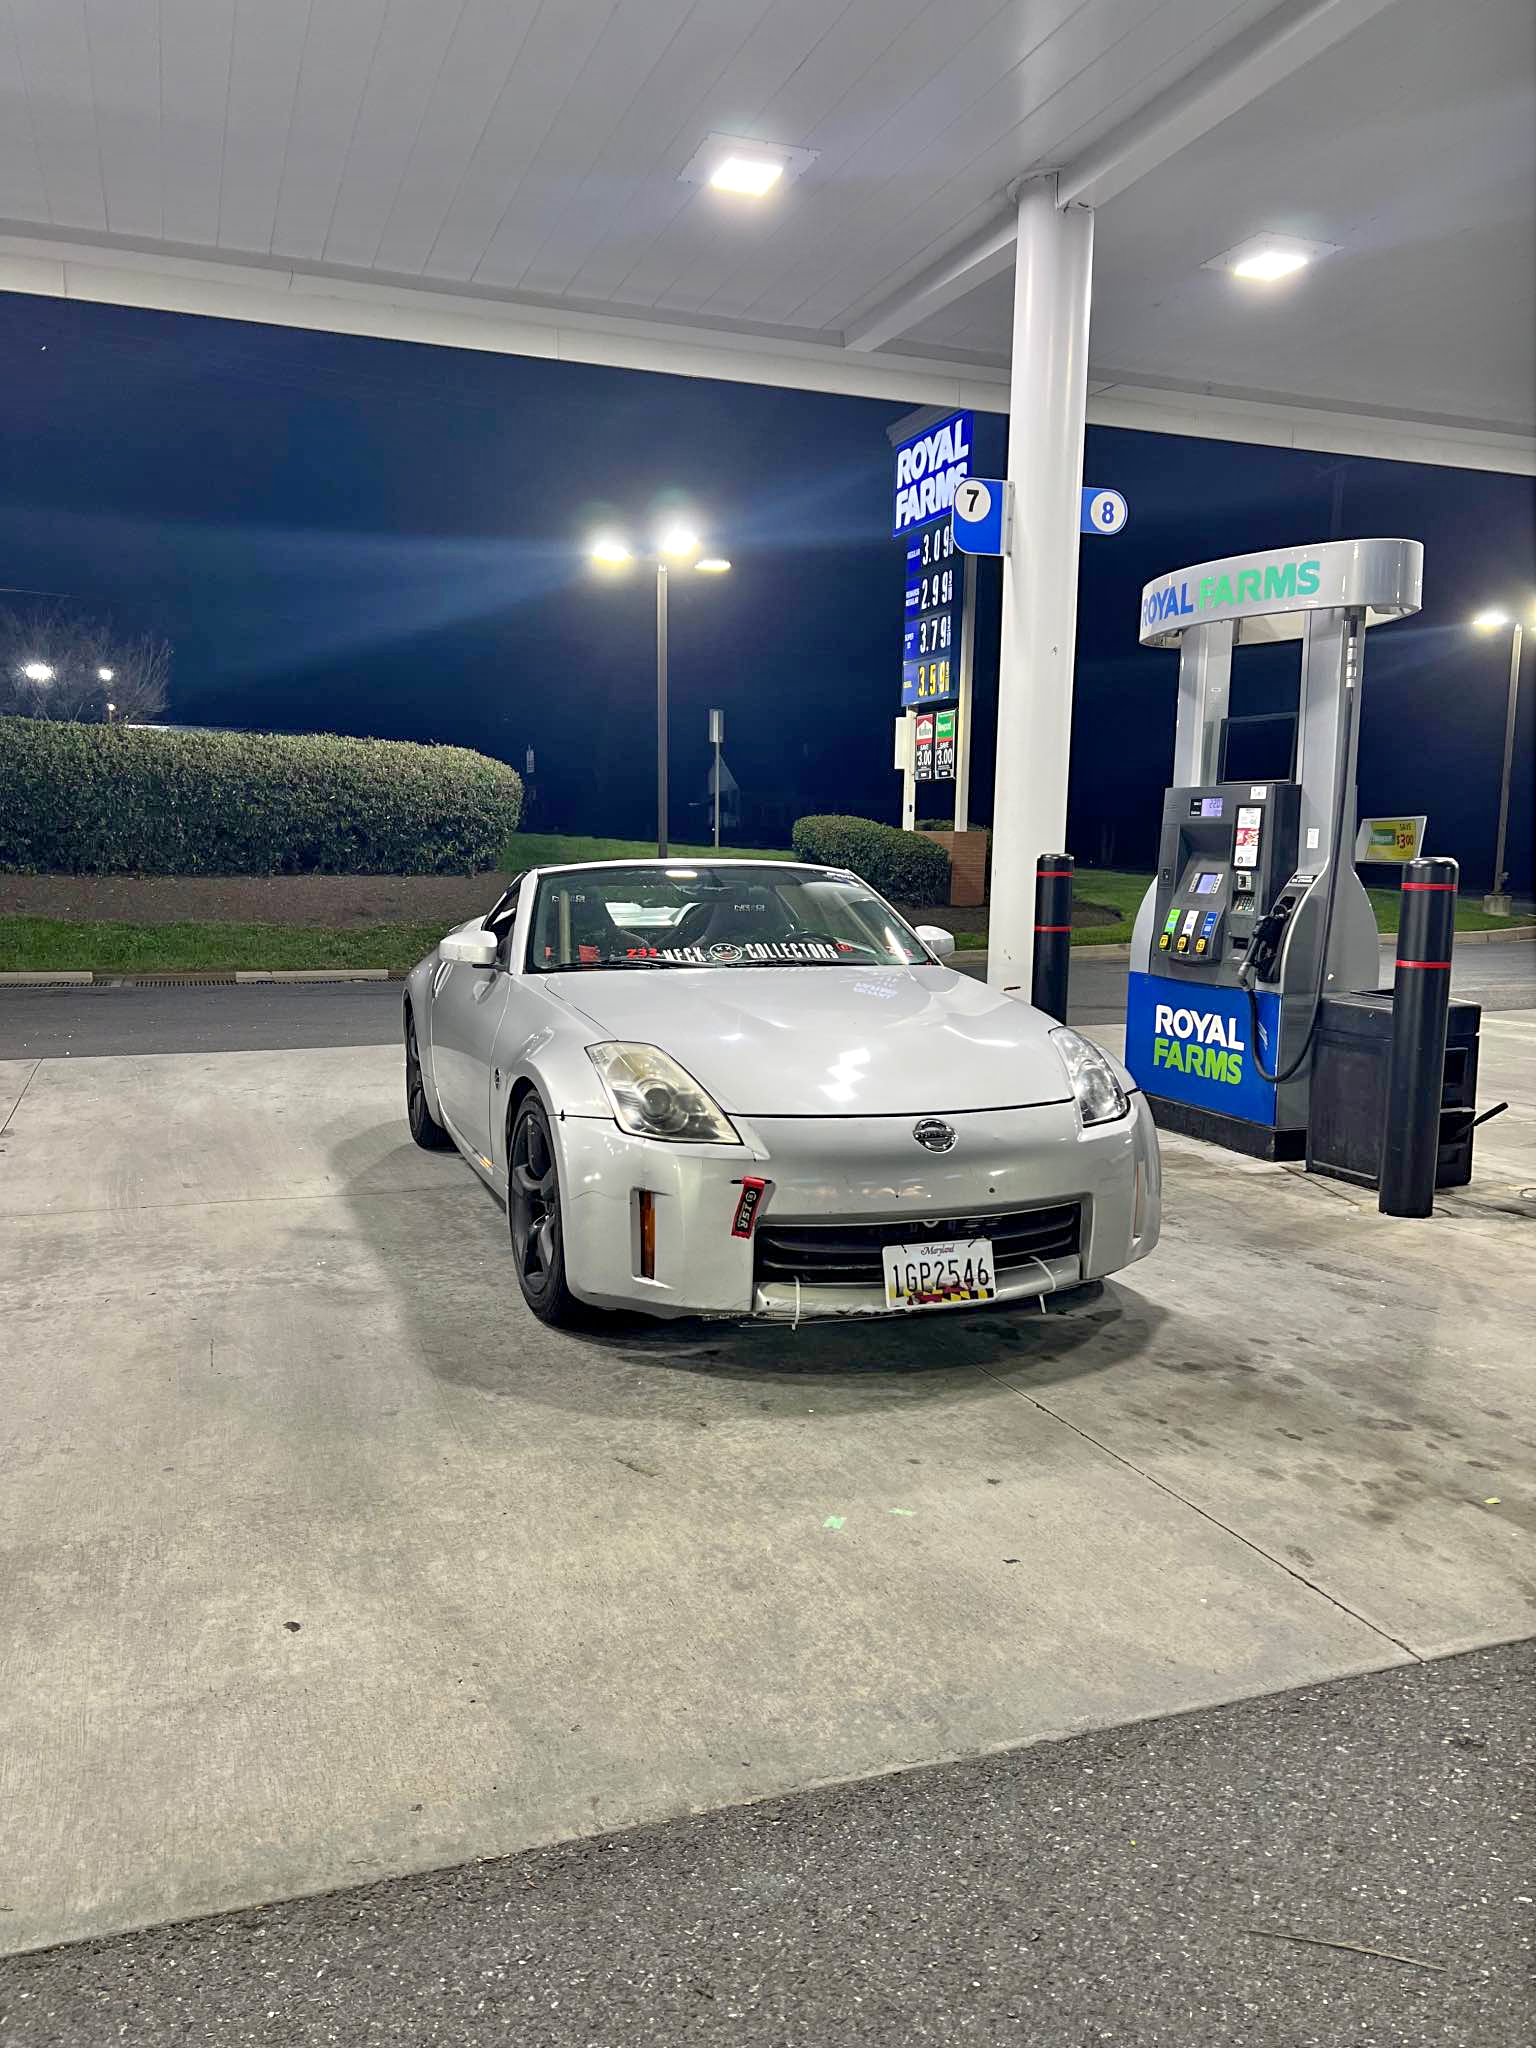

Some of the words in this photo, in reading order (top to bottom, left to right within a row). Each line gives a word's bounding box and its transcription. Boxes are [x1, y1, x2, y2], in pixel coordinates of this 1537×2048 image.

[897, 419, 969, 489] ROYAL
[967, 489, 979, 512] 7
[1102, 501, 1114, 524] 8
[1142, 582, 1194, 627] ROYAL
[1199, 560, 1320, 609] FARMS
[662, 946, 707, 962] NECK
[745, 942, 840, 959] COLLECTORS
[1154, 1004, 1245, 1051] ROYAL
[1153, 1037, 1243, 1085] FARMS
[893, 1257, 989, 1298] 1GP2546
